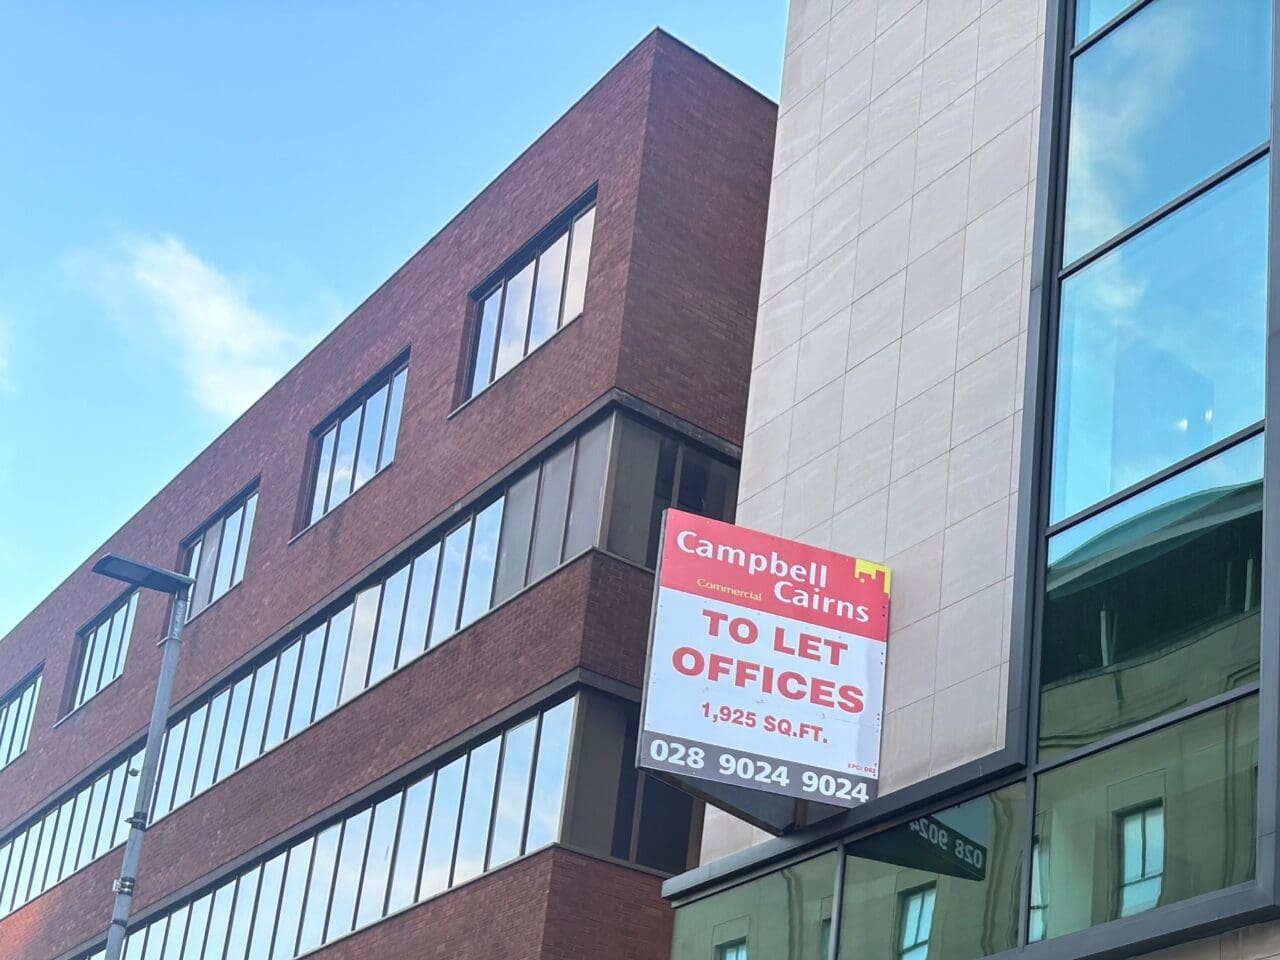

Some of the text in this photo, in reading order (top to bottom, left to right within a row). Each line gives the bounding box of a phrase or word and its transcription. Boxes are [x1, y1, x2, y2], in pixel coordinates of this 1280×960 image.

[676, 529, 828, 588] Campbell
[696, 578, 762, 601] Commercial
[773, 580, 870, 623] Cairns
[702, 608, 849, 666] TO LET
[671, 646, 865, 714] OFFICES
[701, 702, 829, 744] 1,925 SQ.FT.
[650, 738, 870, 803] 028 9024 9024
